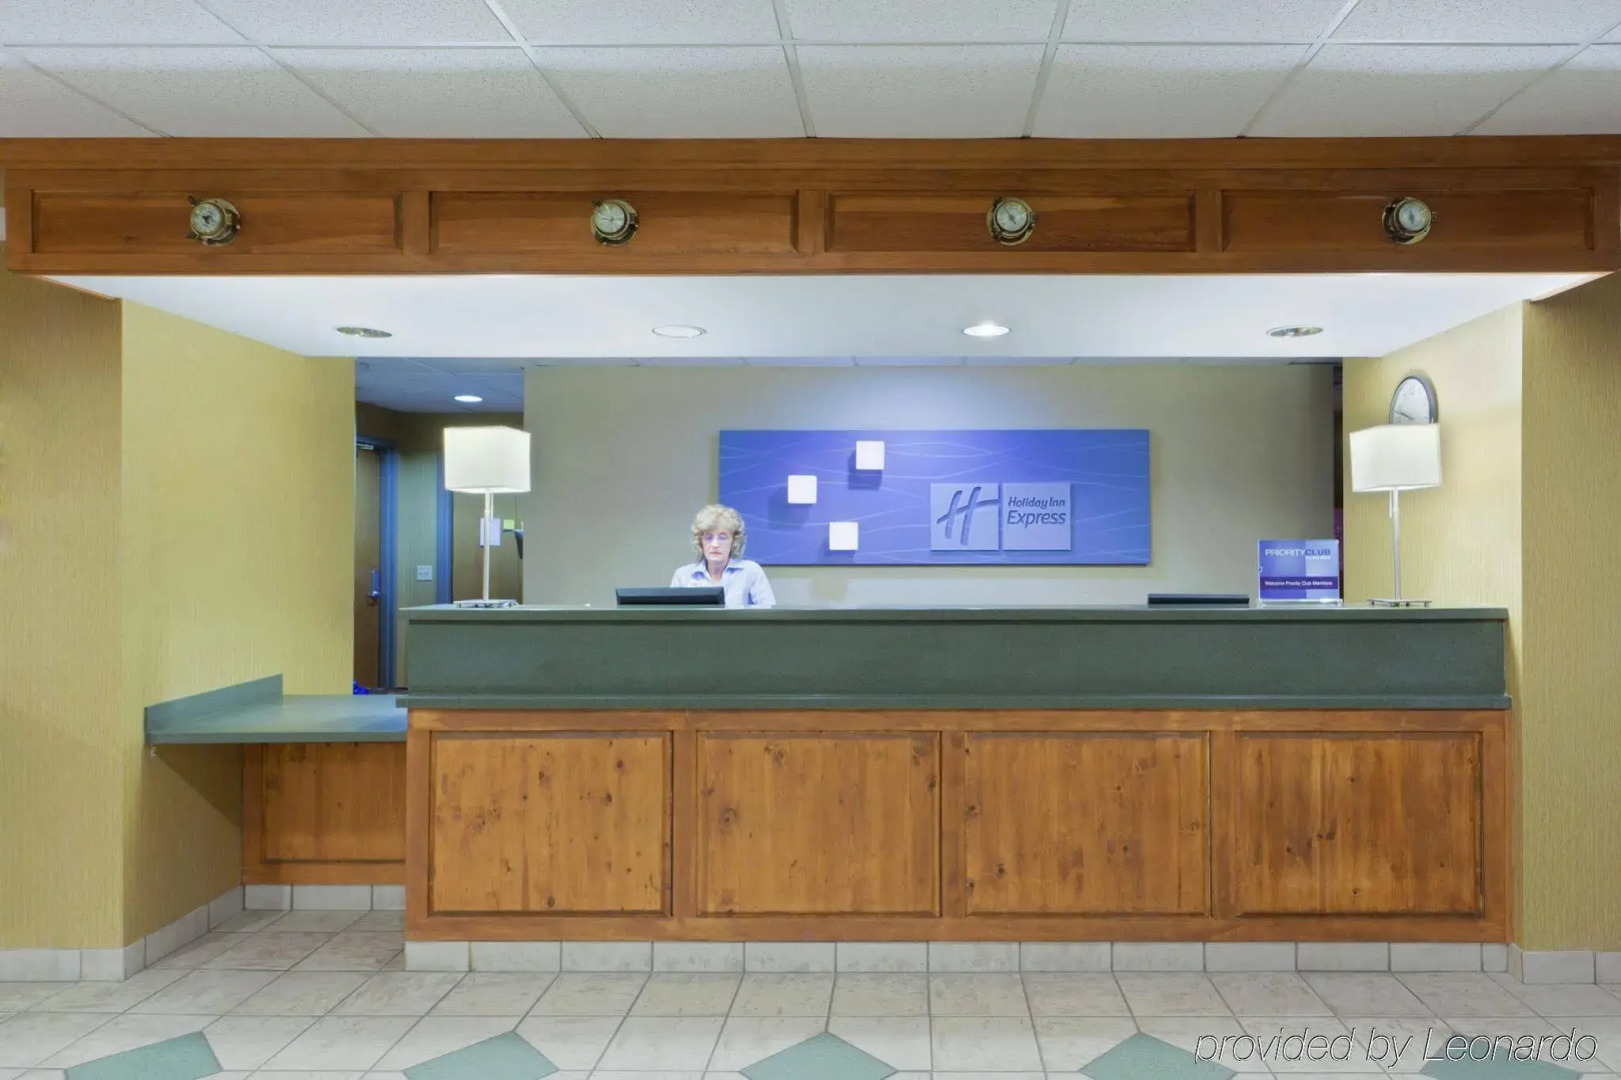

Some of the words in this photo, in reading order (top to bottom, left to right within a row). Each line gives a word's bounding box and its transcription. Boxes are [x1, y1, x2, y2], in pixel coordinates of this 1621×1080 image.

[1008, 497, 1048, 509] Holiday
[1049, 497, 1065, 507] Inn
[1007, 510, 1066, 528] Express
